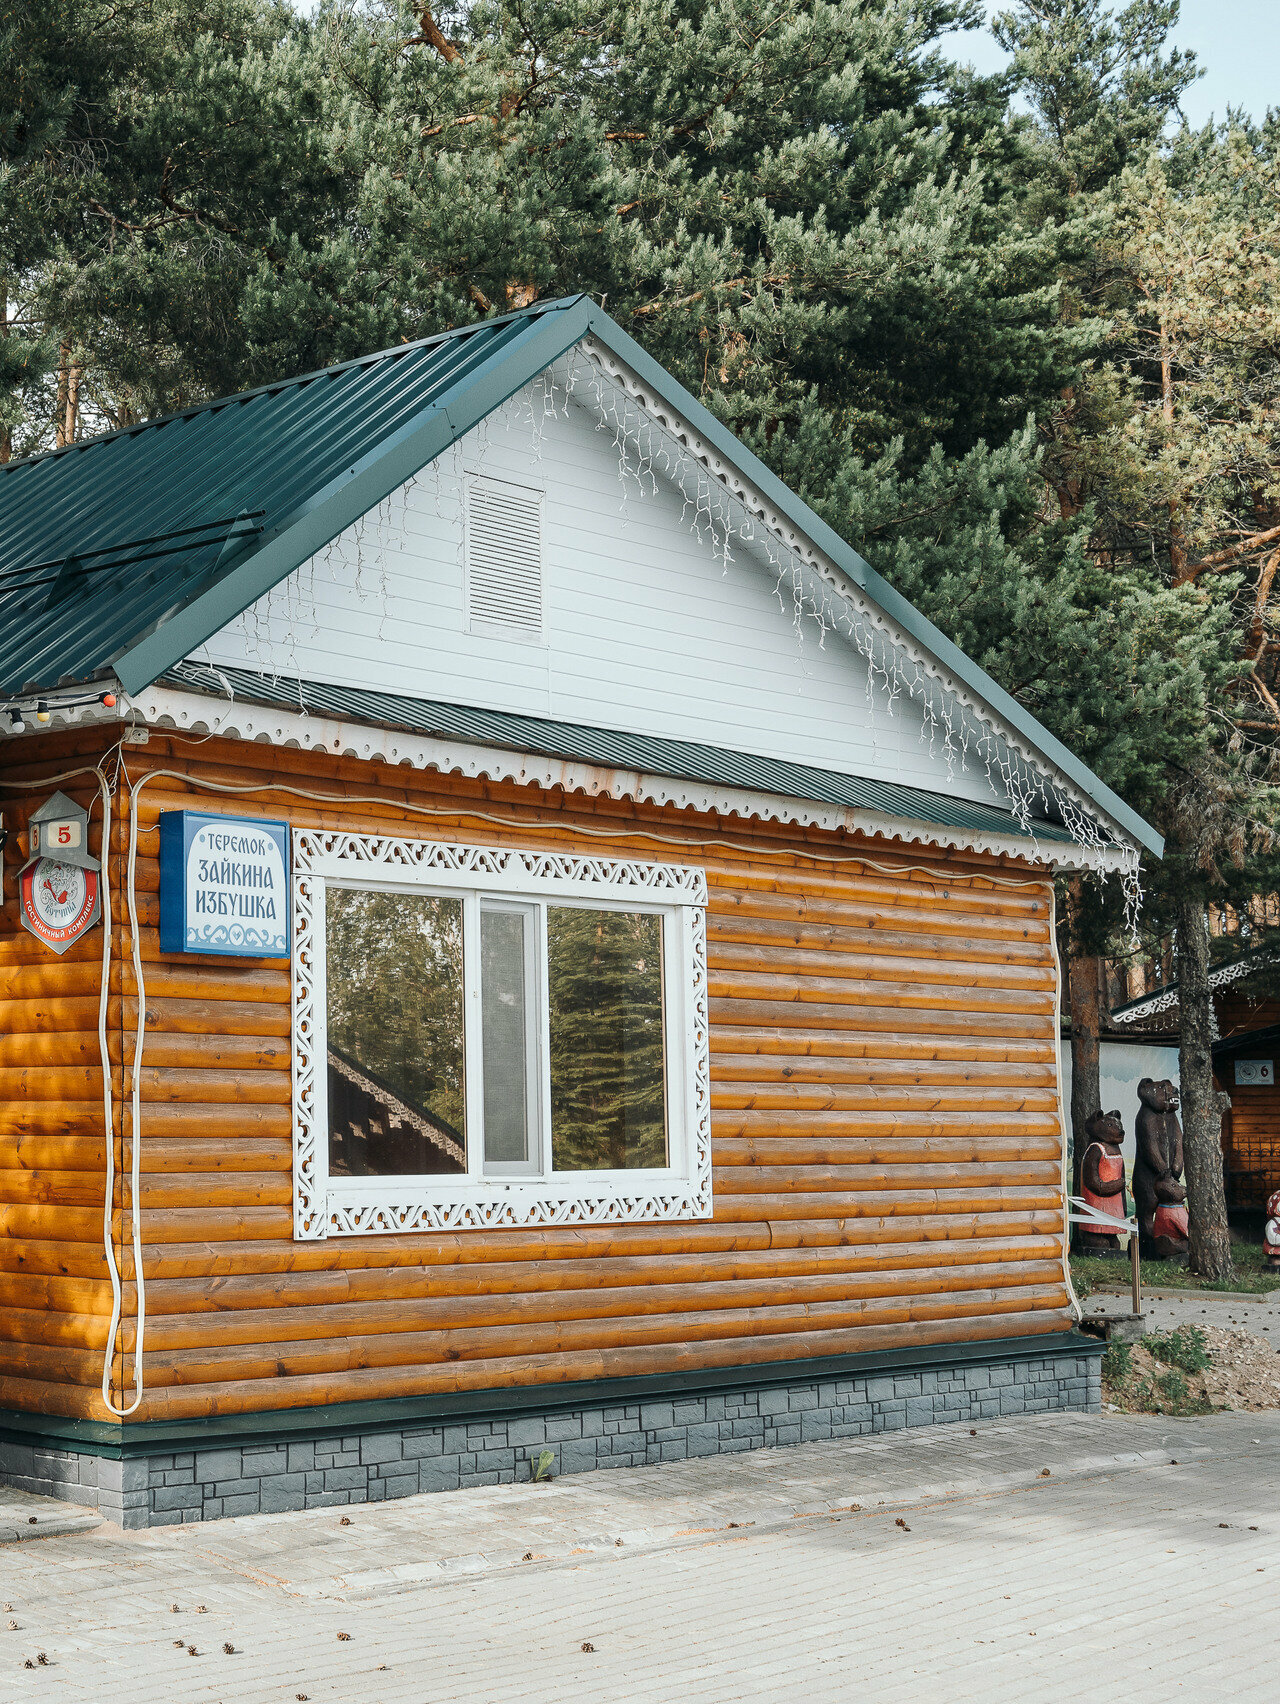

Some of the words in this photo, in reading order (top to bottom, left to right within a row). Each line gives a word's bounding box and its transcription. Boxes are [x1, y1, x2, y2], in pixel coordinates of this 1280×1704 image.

[58, 825, 71, 844] 5
[208, 833, 266, 856] ТЕРЕМОК
[198, 857, 274, 890] ЗАЙКИНА
[26, 900, 66, 938] ГОСТИНИЧНЫЙ
[68, 895, 94, 935] КОМПЛЕКС
[195, 890, 277, 920] ИЗБУШКА
[1260, 1063, 1269, 1078] 6
